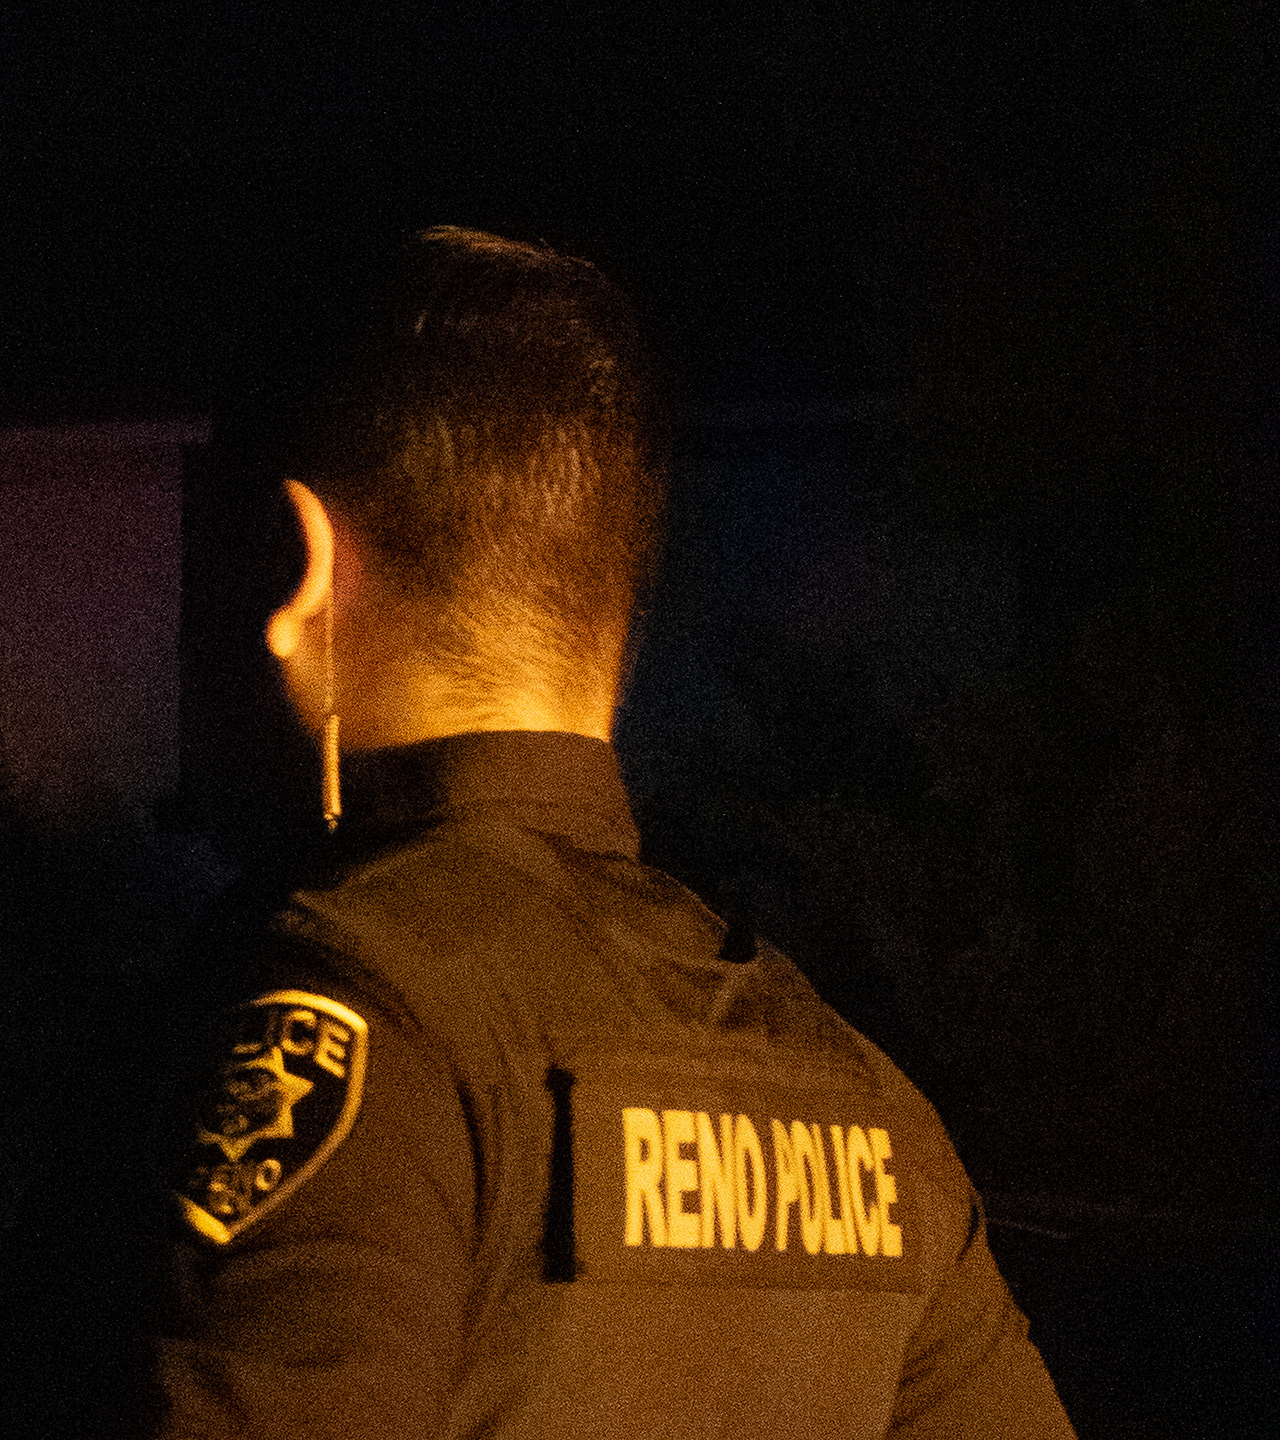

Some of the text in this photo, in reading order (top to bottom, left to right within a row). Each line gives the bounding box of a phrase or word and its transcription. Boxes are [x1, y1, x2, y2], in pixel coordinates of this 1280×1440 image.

[231, 1007, 351, 1080] ICE
[622, 1106, 903, 1257] RENO POLICE
